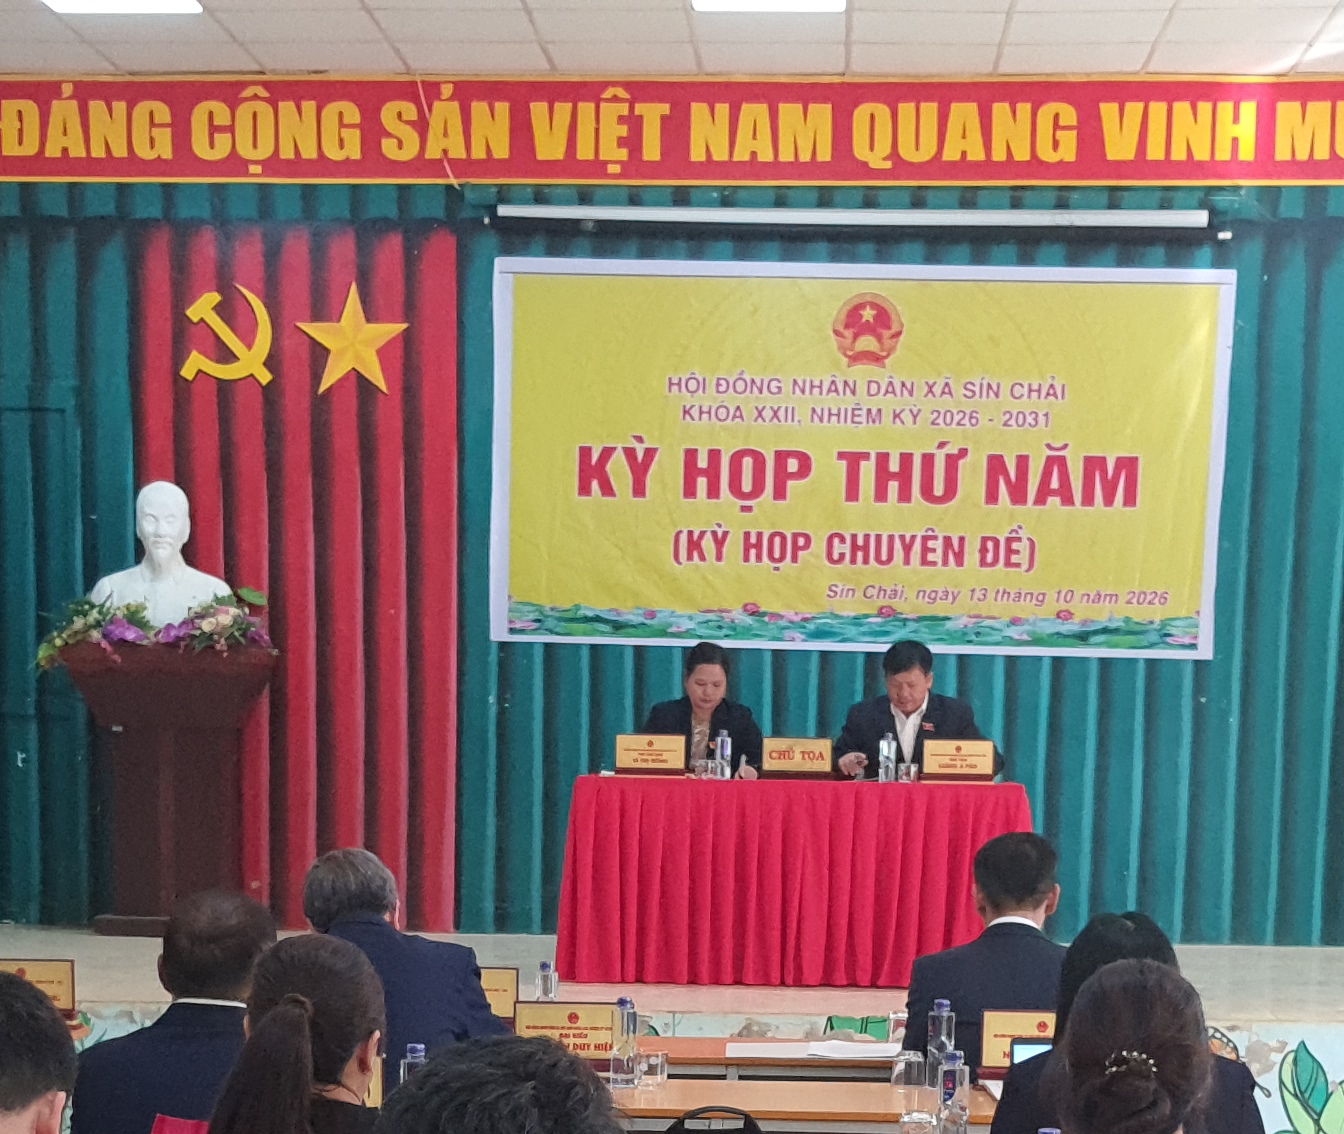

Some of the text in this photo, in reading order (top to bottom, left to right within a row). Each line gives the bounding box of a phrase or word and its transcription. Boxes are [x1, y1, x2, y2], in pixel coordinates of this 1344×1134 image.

[190, 85, 362, 174] CỘNG
[379, 83, 511, 162] SẢN
[530, 87, 671, 174] VIỆT
[688, 101, 833, 163] NAM
[852, 101, 1079, 170] QUANG
[1098, 100, 1257, 162] VINH
[667, 369, 1067, 401] HỘI ĐỒNG NHÂN DÂN XÃ SÍN CHẢI
[681, 400, 746, 423] KHÓA
[753, 405, 803, 427] XXII,
[809, 402, 883, 429] NHIỆM
[891, 404, 923, 426] KỲ
[929, 408, 981, 428] 2026
[1002, 410, 1052, 429] 2031
[576, 434, 1141, 514] KỲ HỌP THỨ NĂM
[673, 521, 1038, 574] (KỲ HỌP CHUYÊN ĐỀ)
[915, 586, 962, 606] ngày
[968, 587, 989, 603] 13
[993, 587, 1048, 608] tháng
[1055, 588, 1075, 605] 10
[1079, 590, 1120, 606] năm
[1125, 590, 1170, 607] 2026
